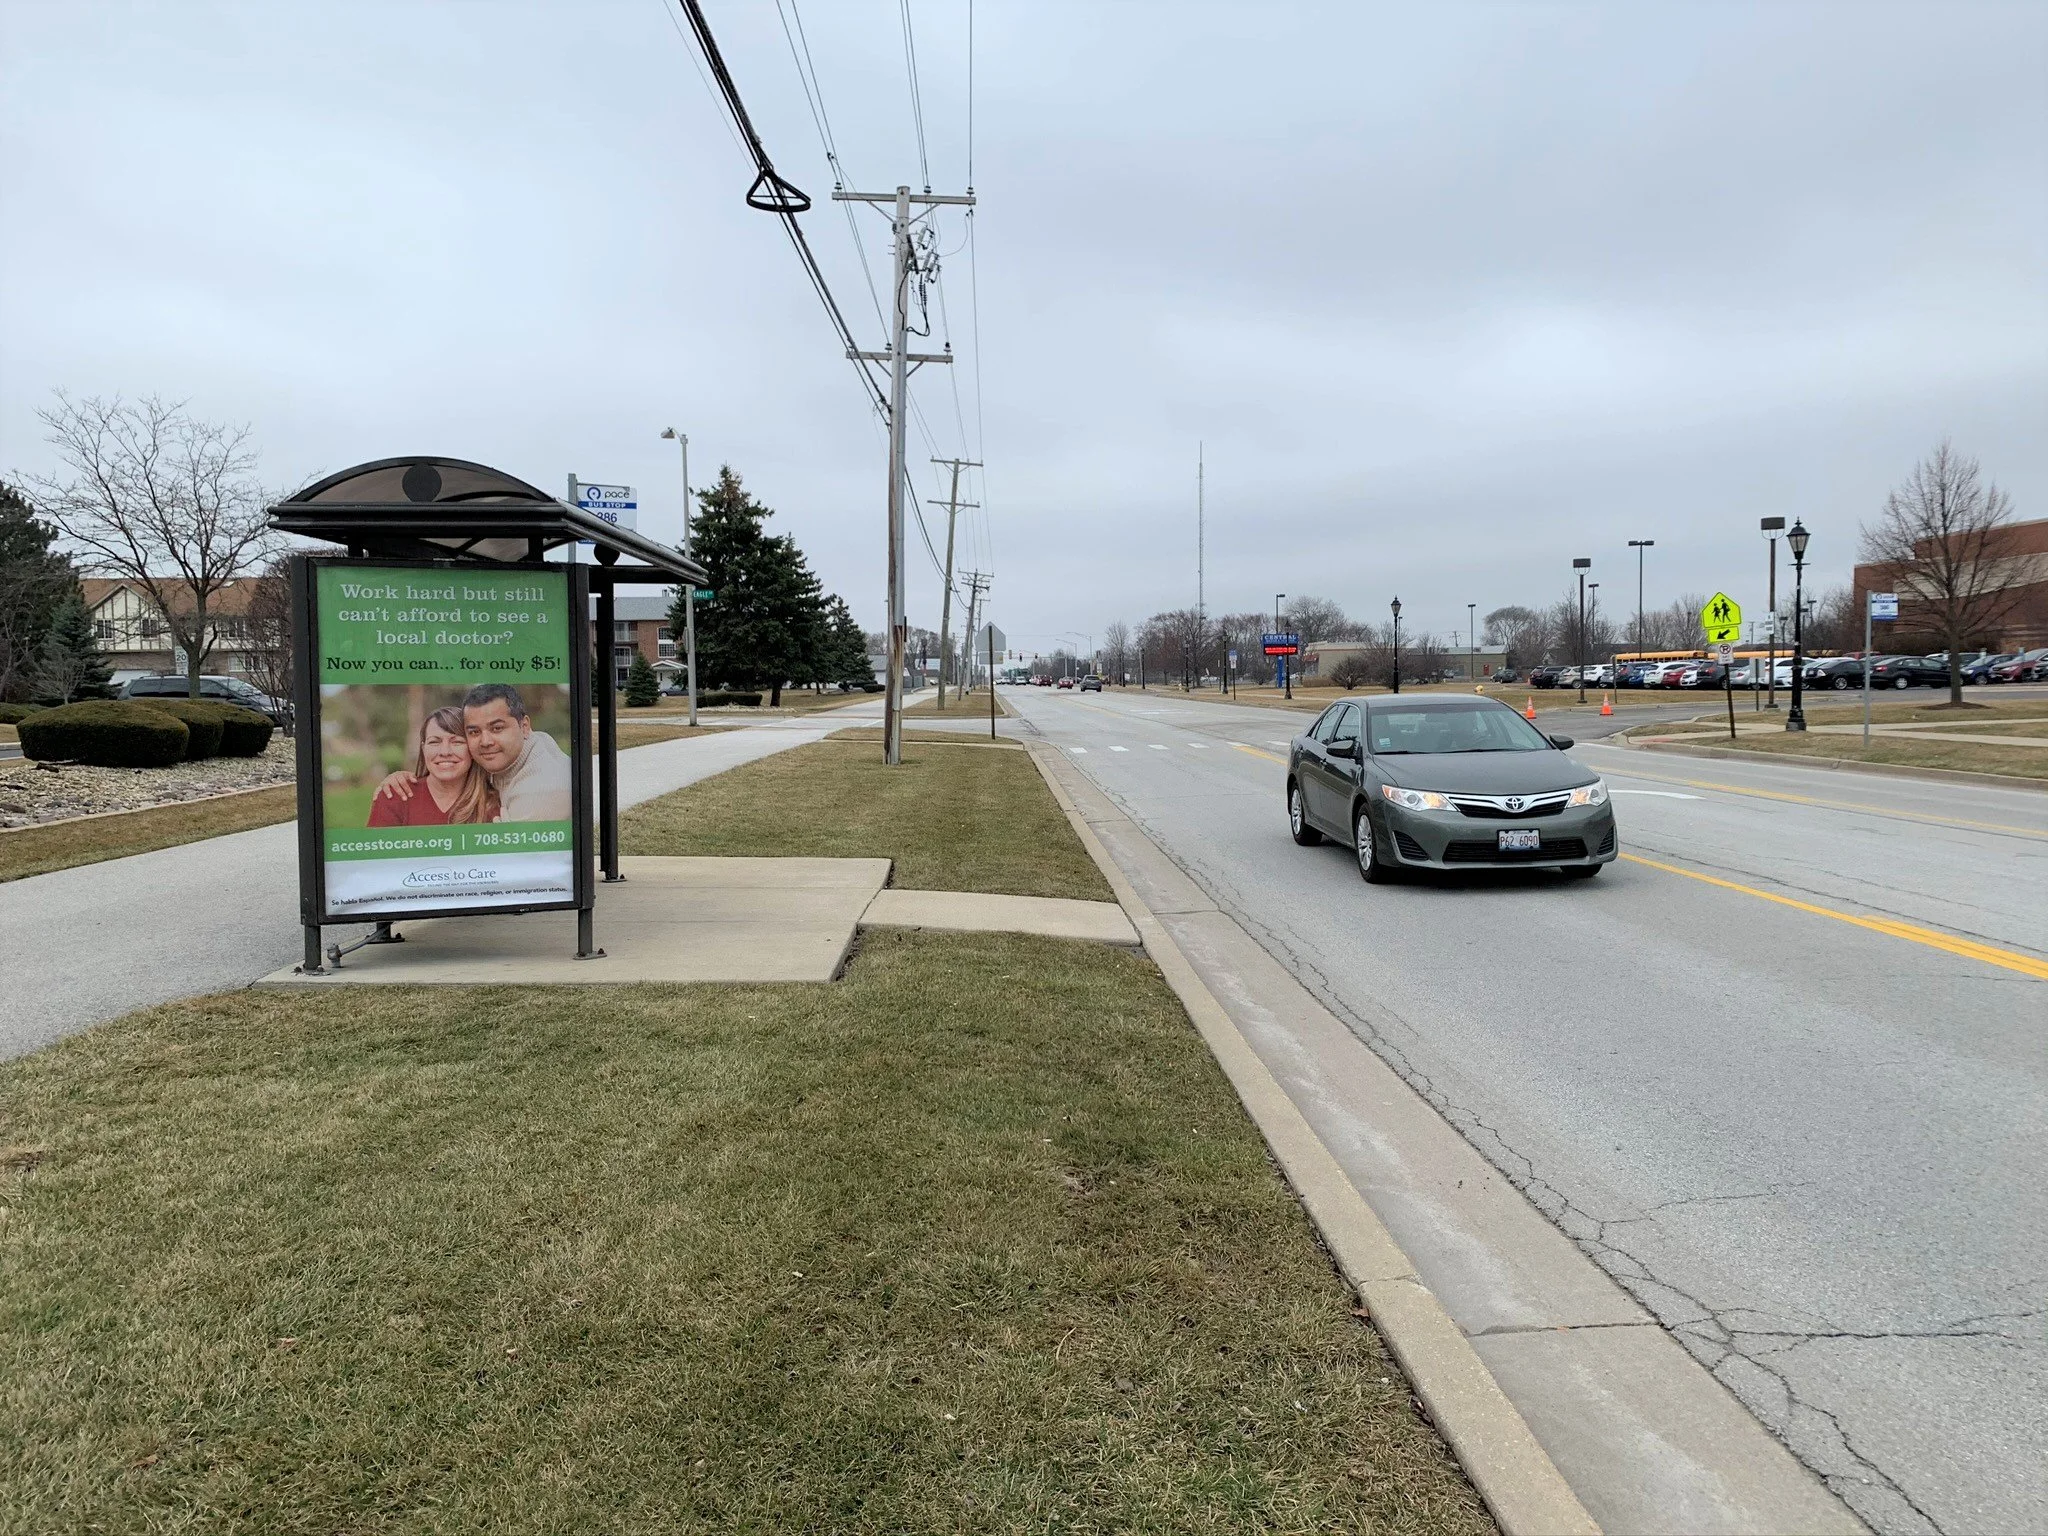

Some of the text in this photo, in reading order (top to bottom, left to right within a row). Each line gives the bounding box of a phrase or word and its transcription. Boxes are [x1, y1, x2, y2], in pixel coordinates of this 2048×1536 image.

[340, 584, 545, 602] Work hard but still
[338, 608, 548, 624] can't afford to see a
[376, 630, 514, 645] local doctor?
[326, 655, 561, 672] Now you can... for only $5!
[332, 830, 566, 852] accesstocare.org 708-531-0680
[408, 868, 496, 882] Access to Care
